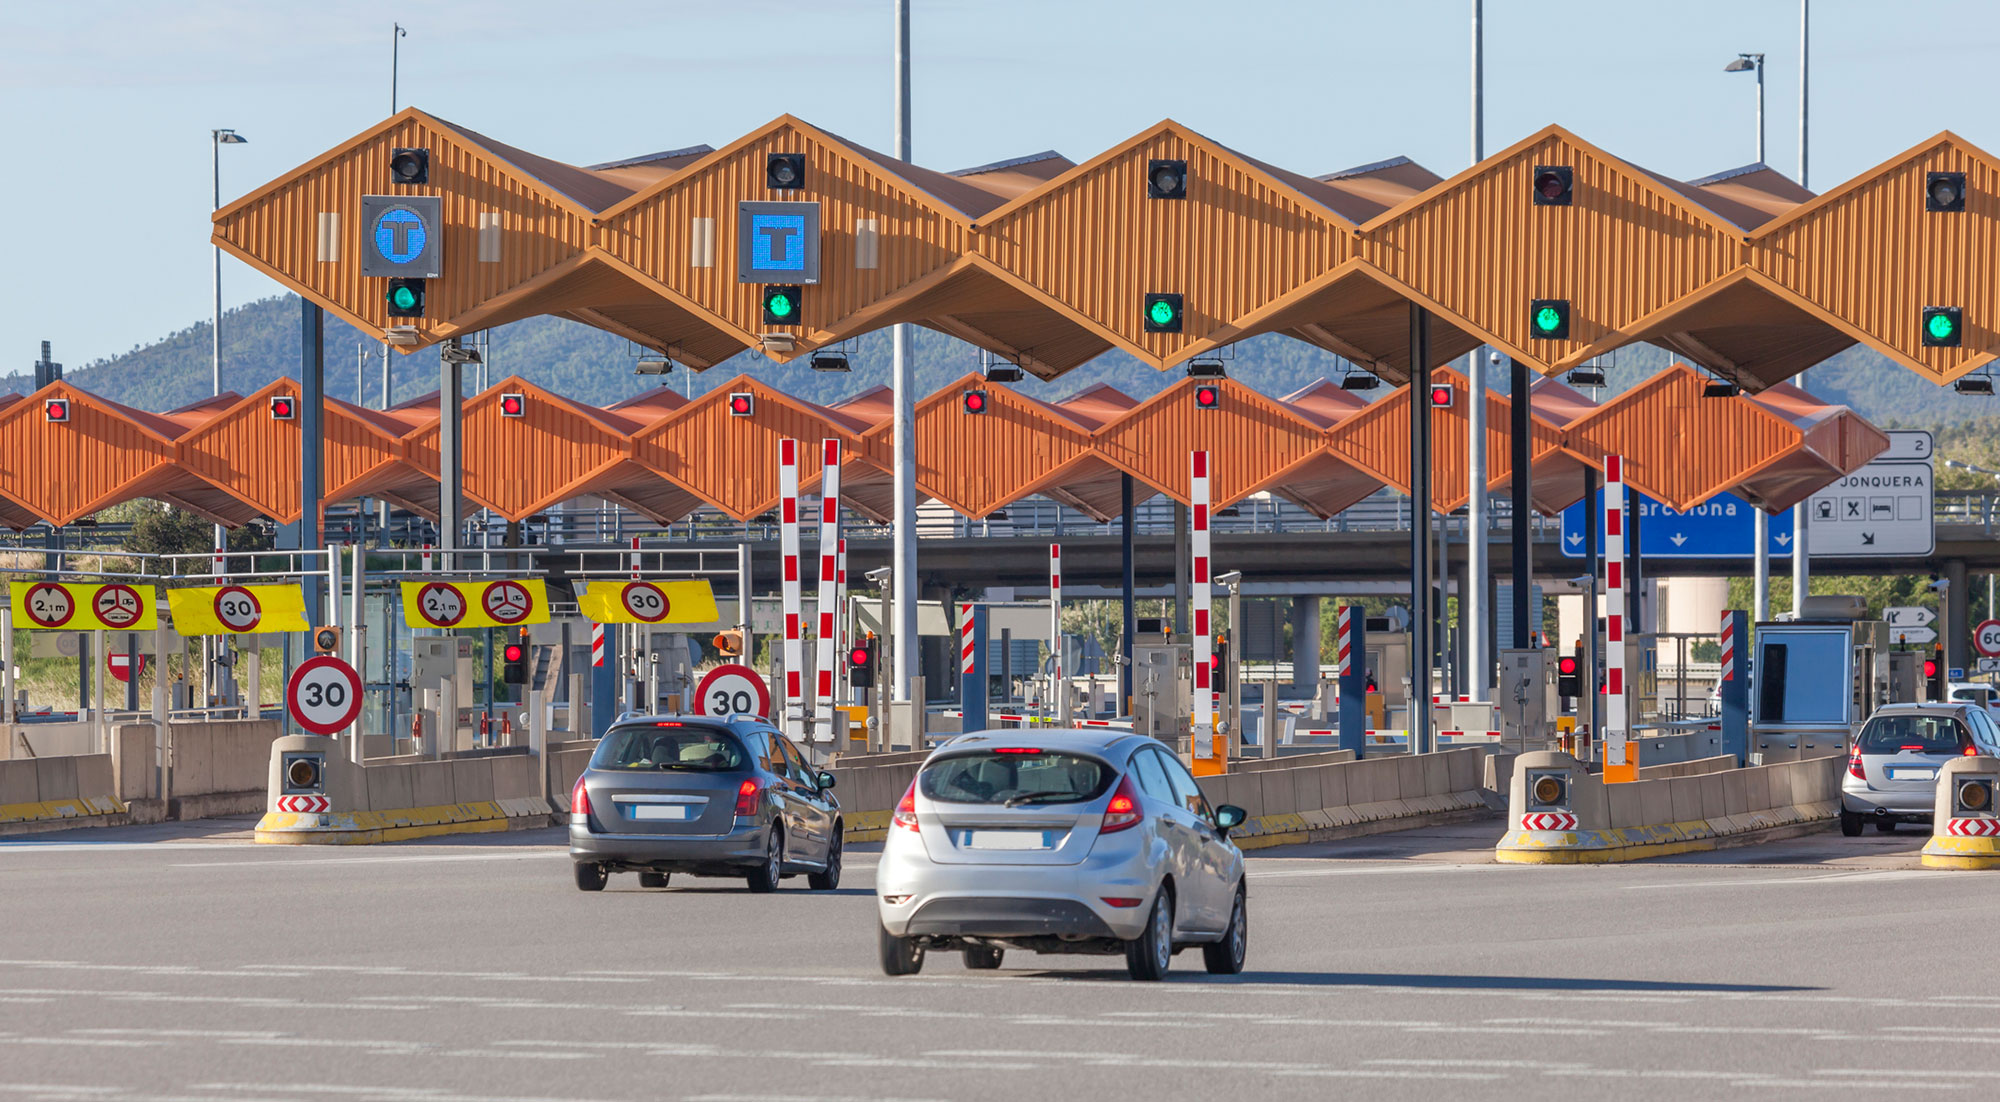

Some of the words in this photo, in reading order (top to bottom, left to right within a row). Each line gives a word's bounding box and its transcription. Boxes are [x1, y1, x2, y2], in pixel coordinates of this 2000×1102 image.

[382, 221, 419, 255] T
[759, 226, 798, 261] T
[1915, 440, 1924, 451] 2
[1840, 476, 1924, 487] JONQUERA
[1622, 499, 1737, 517] arclona
[224, 601, 251, 616] 30
[632, 595, 659, 609] 30
[1917, 612, 1925, 621] 2
[1983, 632, 2000, 645] 60
[305, 682, 345, 707] 30
[712, 690, 752, 716] 30
